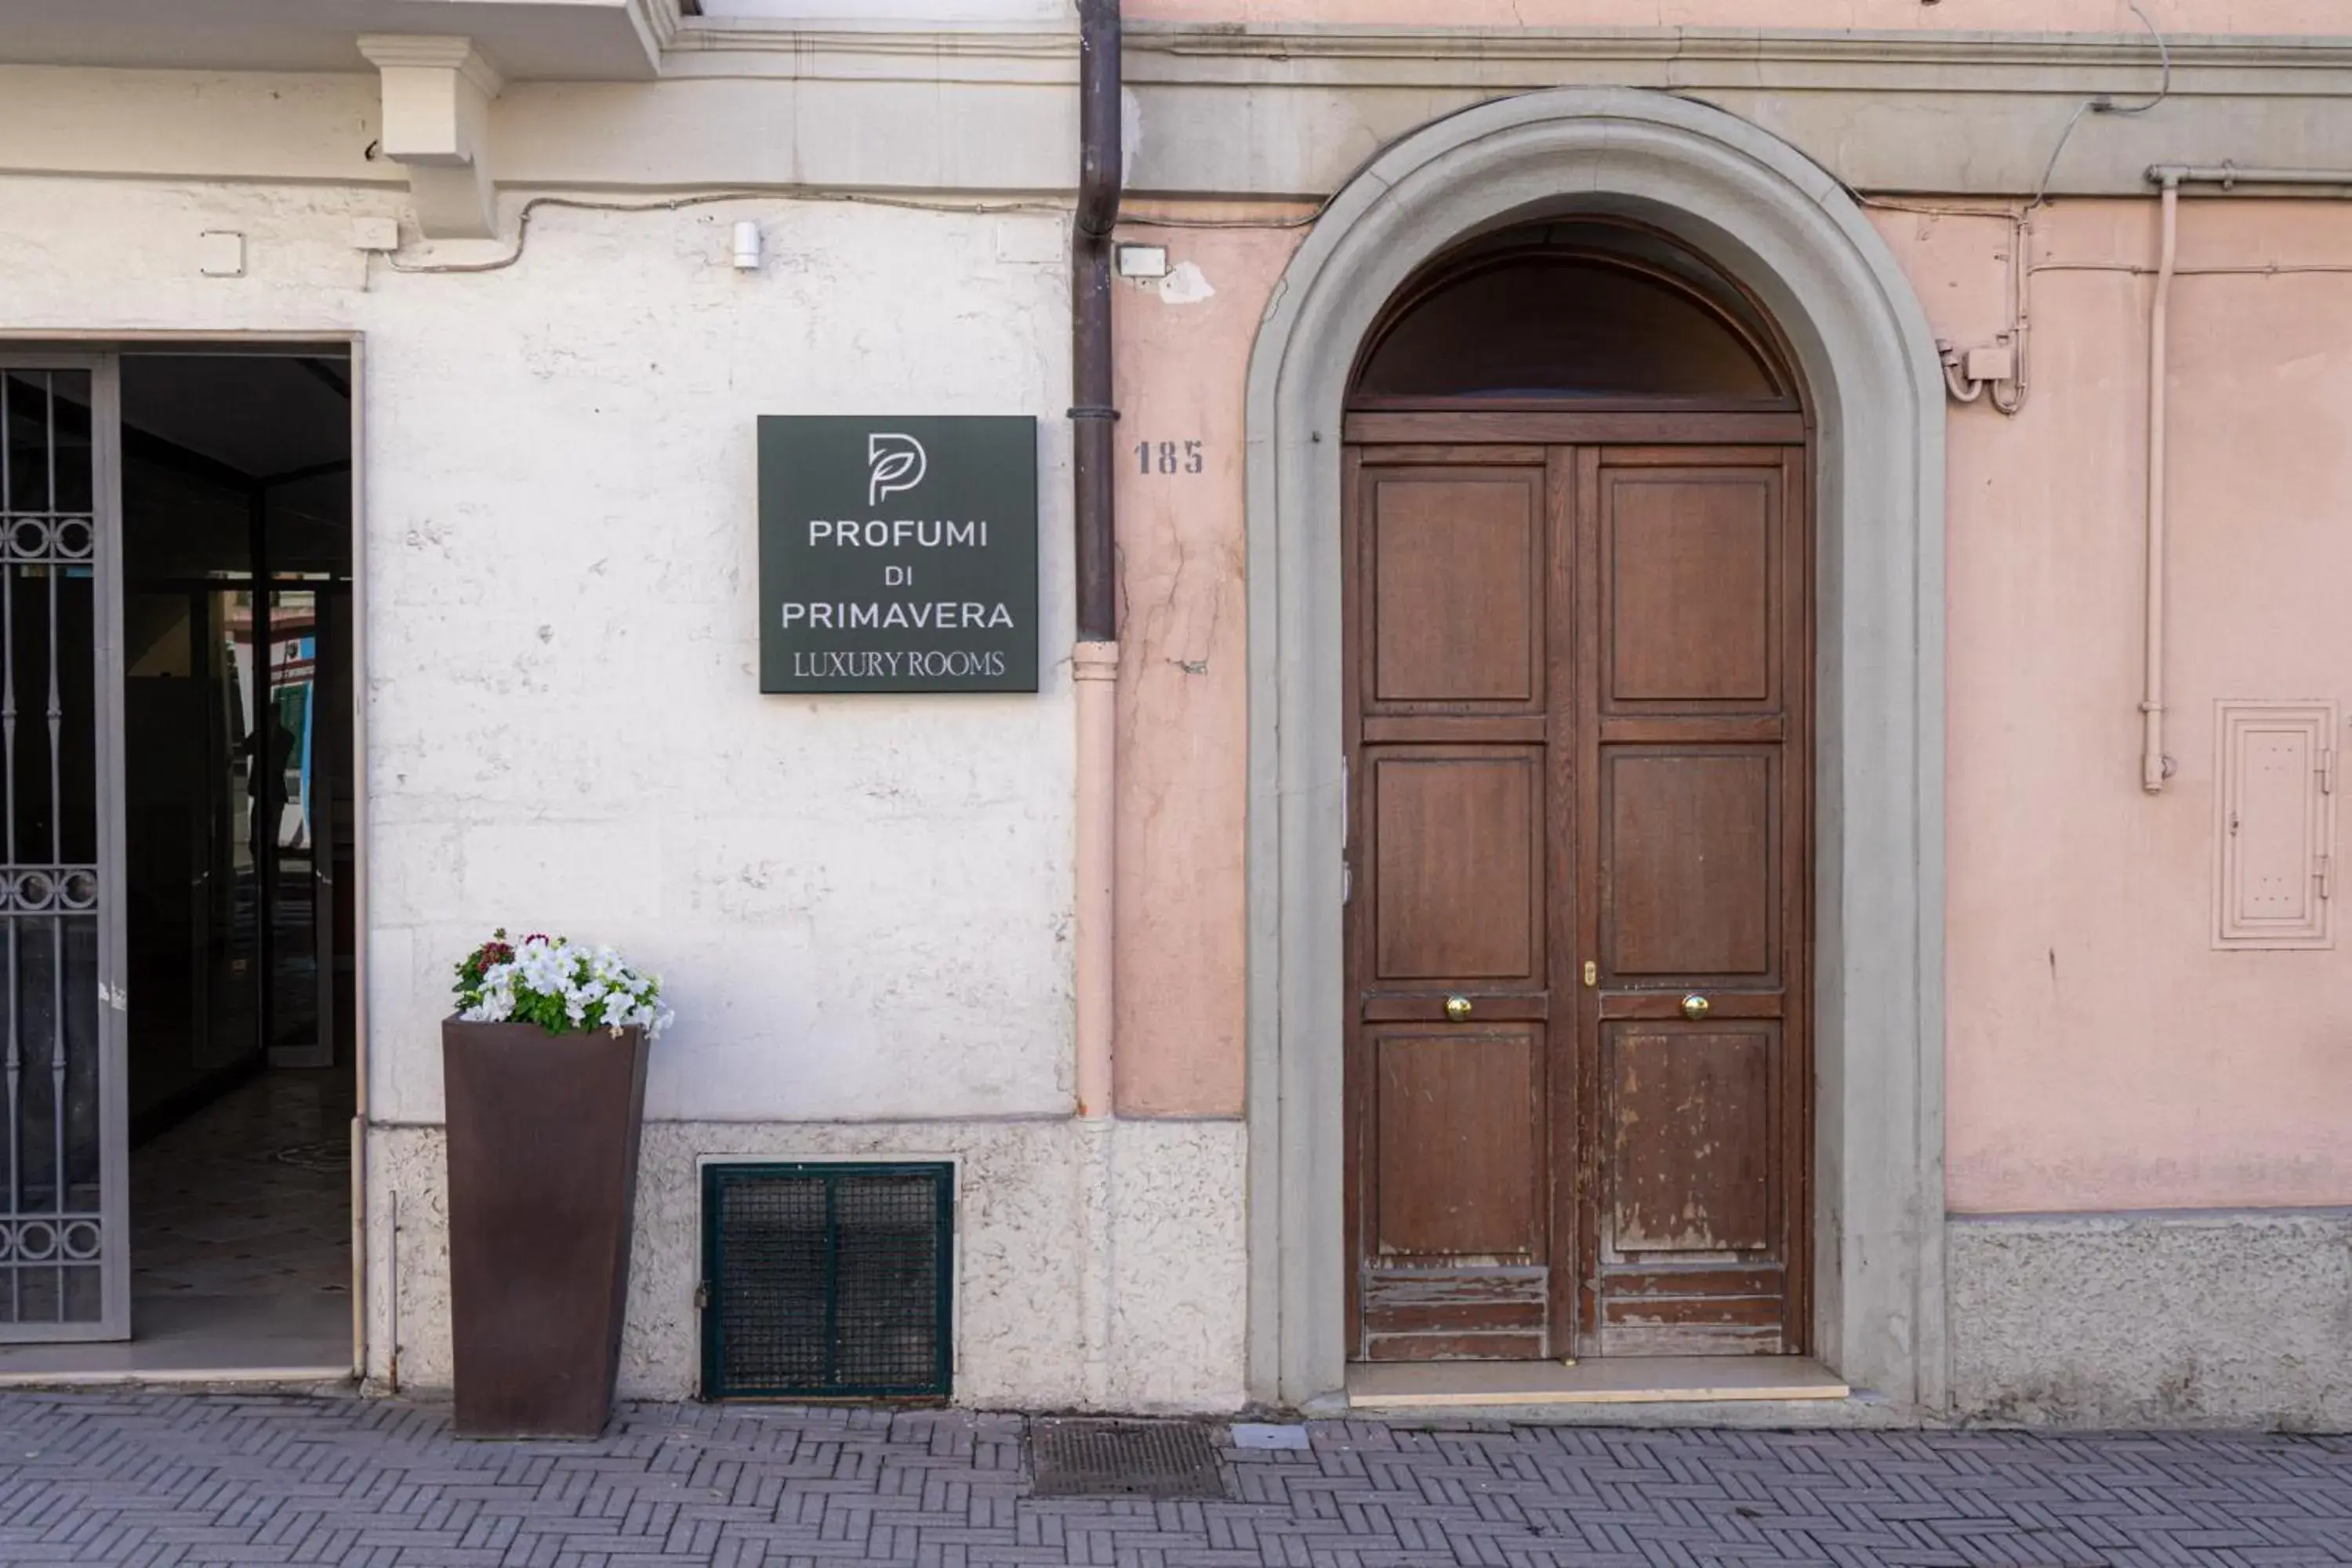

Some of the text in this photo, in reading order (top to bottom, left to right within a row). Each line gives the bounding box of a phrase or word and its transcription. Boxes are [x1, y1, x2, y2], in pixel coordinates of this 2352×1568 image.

[1134, 441, 1203, 475] 185
[809, 521, 987, 547] PROFUMI
[885, 565, 913, 586] DI
[782, 602, 1014, 629] PRIMAVERA
[793, 651, 1005, 677] LUXURY ROOMS
